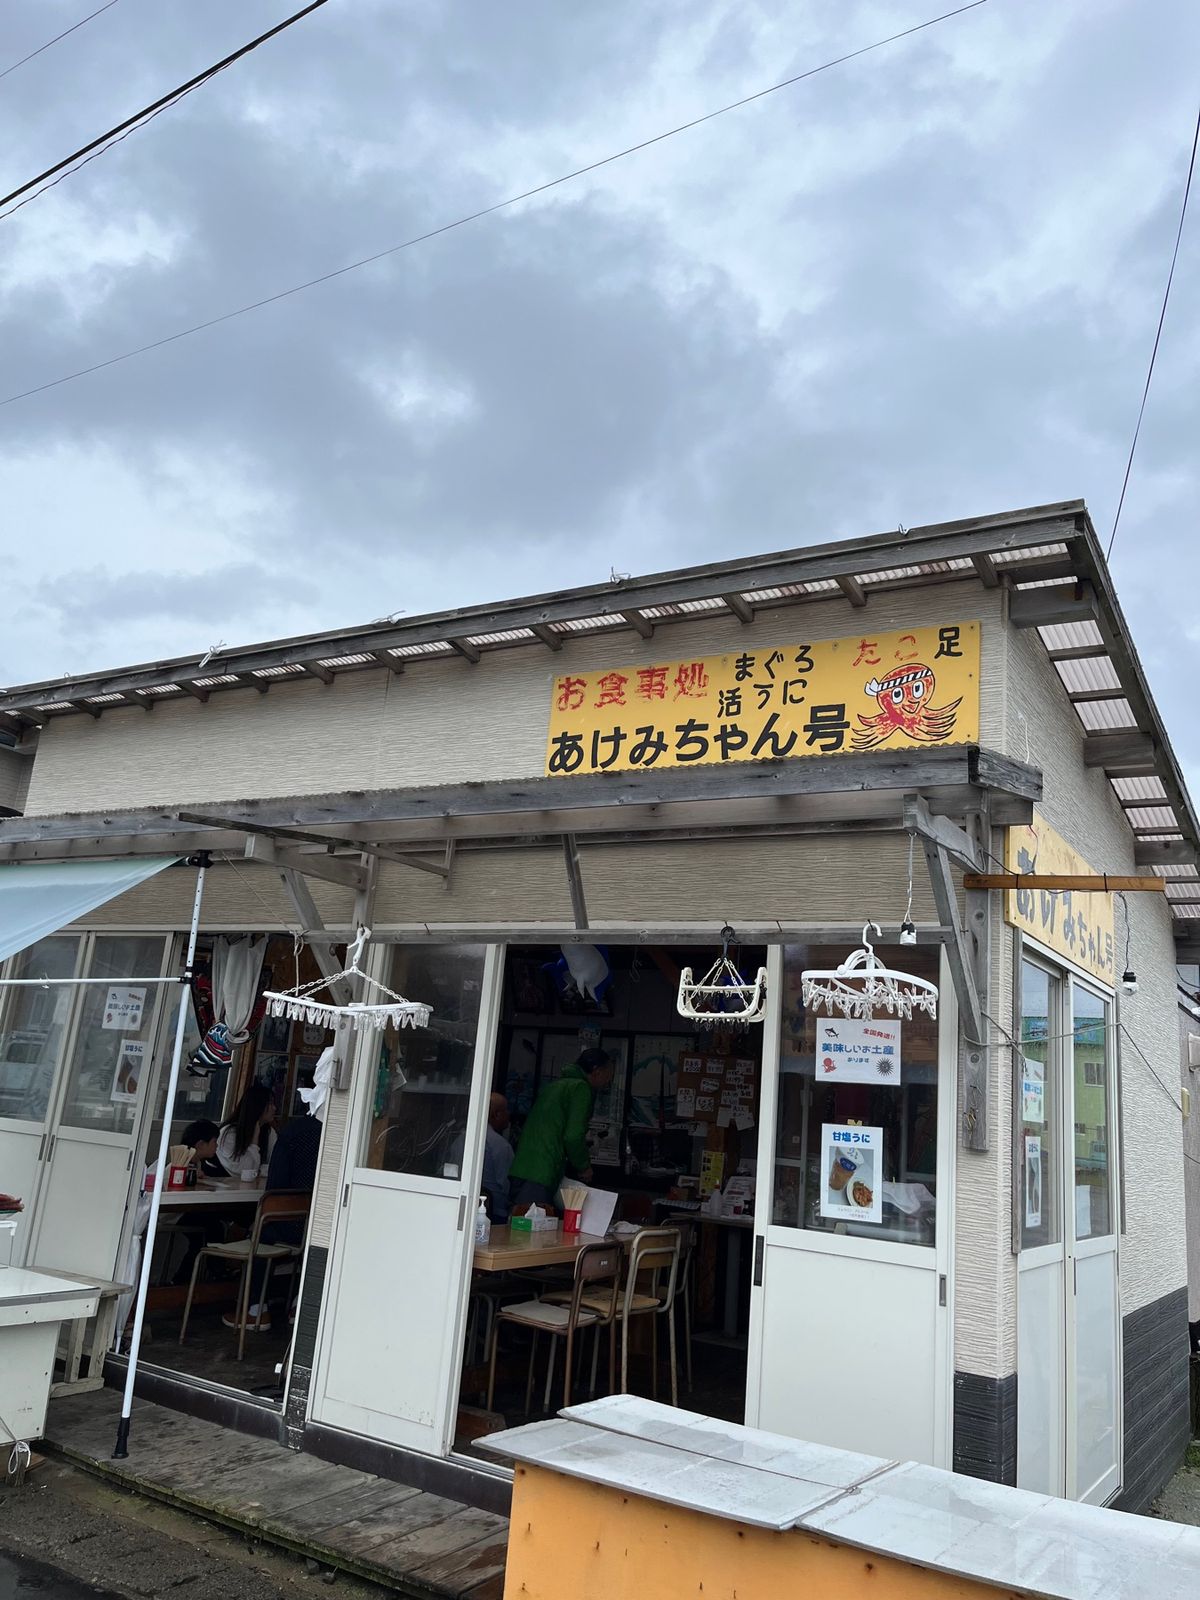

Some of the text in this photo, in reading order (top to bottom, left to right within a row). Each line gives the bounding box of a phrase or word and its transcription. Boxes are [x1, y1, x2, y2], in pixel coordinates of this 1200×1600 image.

[735, 645, 814, 681] まぐろ
[556, 662, 709, 711] お食事処
[717, 678, 808, 718] 活うに
[821, 1042, 895, 1055] 美味しいお土産
[832, 1130, 871, 1144] 甘塩うに
